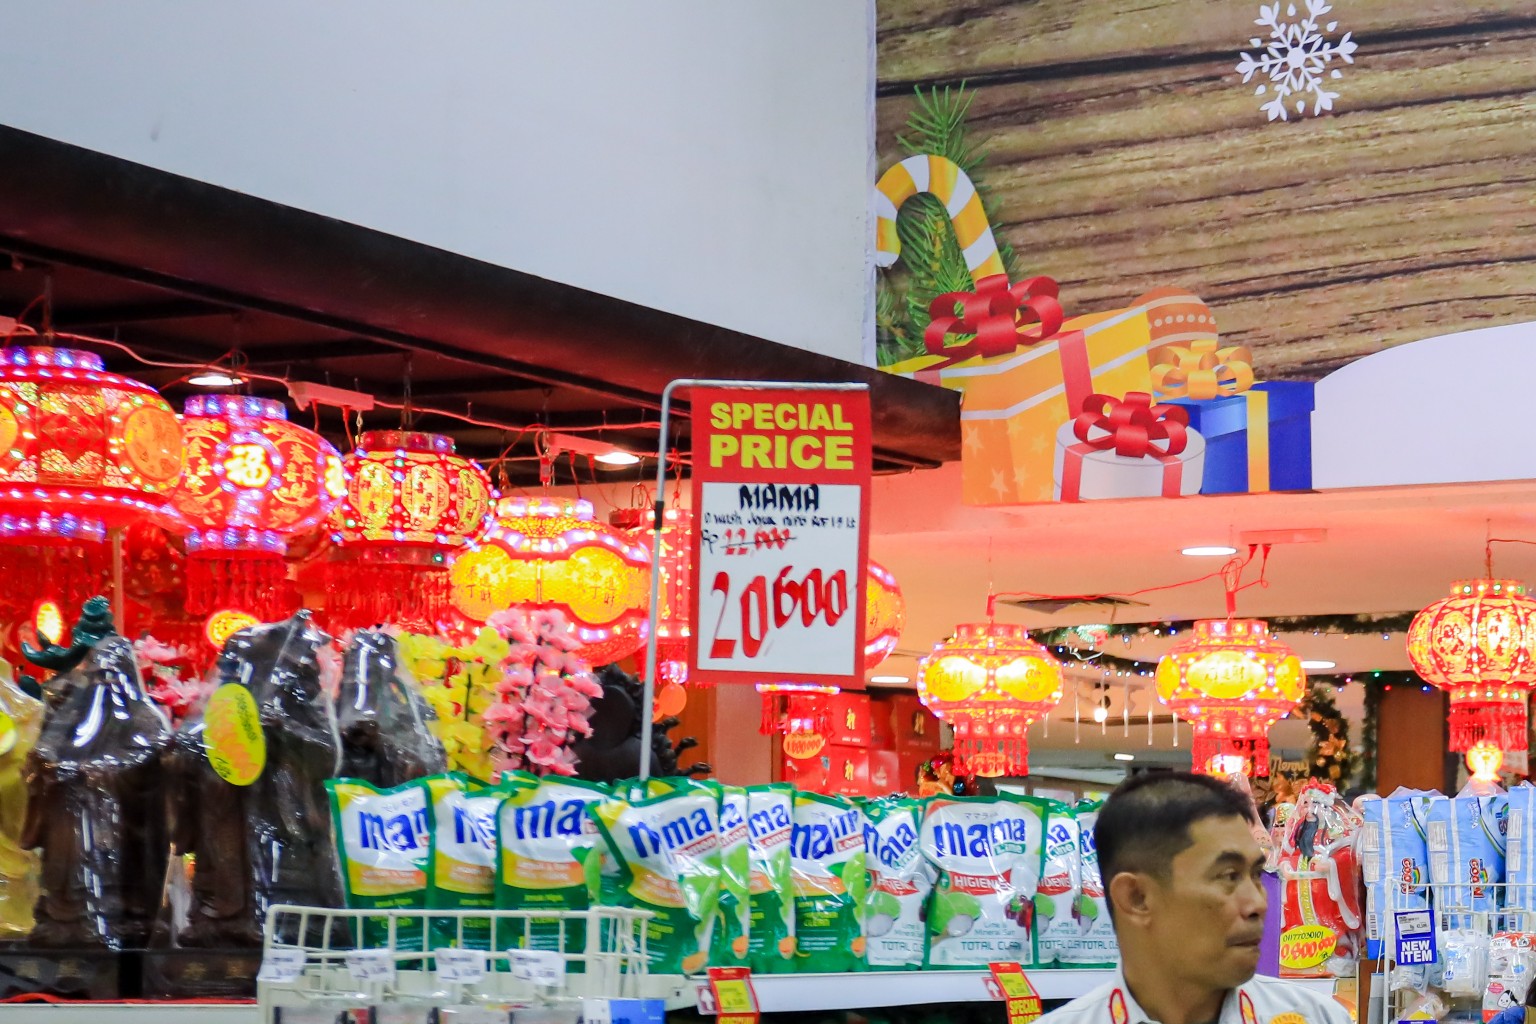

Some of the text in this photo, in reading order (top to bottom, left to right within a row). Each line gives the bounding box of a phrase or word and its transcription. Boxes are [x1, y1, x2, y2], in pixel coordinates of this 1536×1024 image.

[710, 402, 854, 430] SPECIAL
[709, 434, 855, 470] PRICE
[738, 483, 819, 511] MAMA
[932, 817, 1026, 859] mama
[1400, 950, 1433, 964] ITEM
[1402, 940, 1430, 951] NEW
[1009, 998, 1041, 1016] SPECIAL
